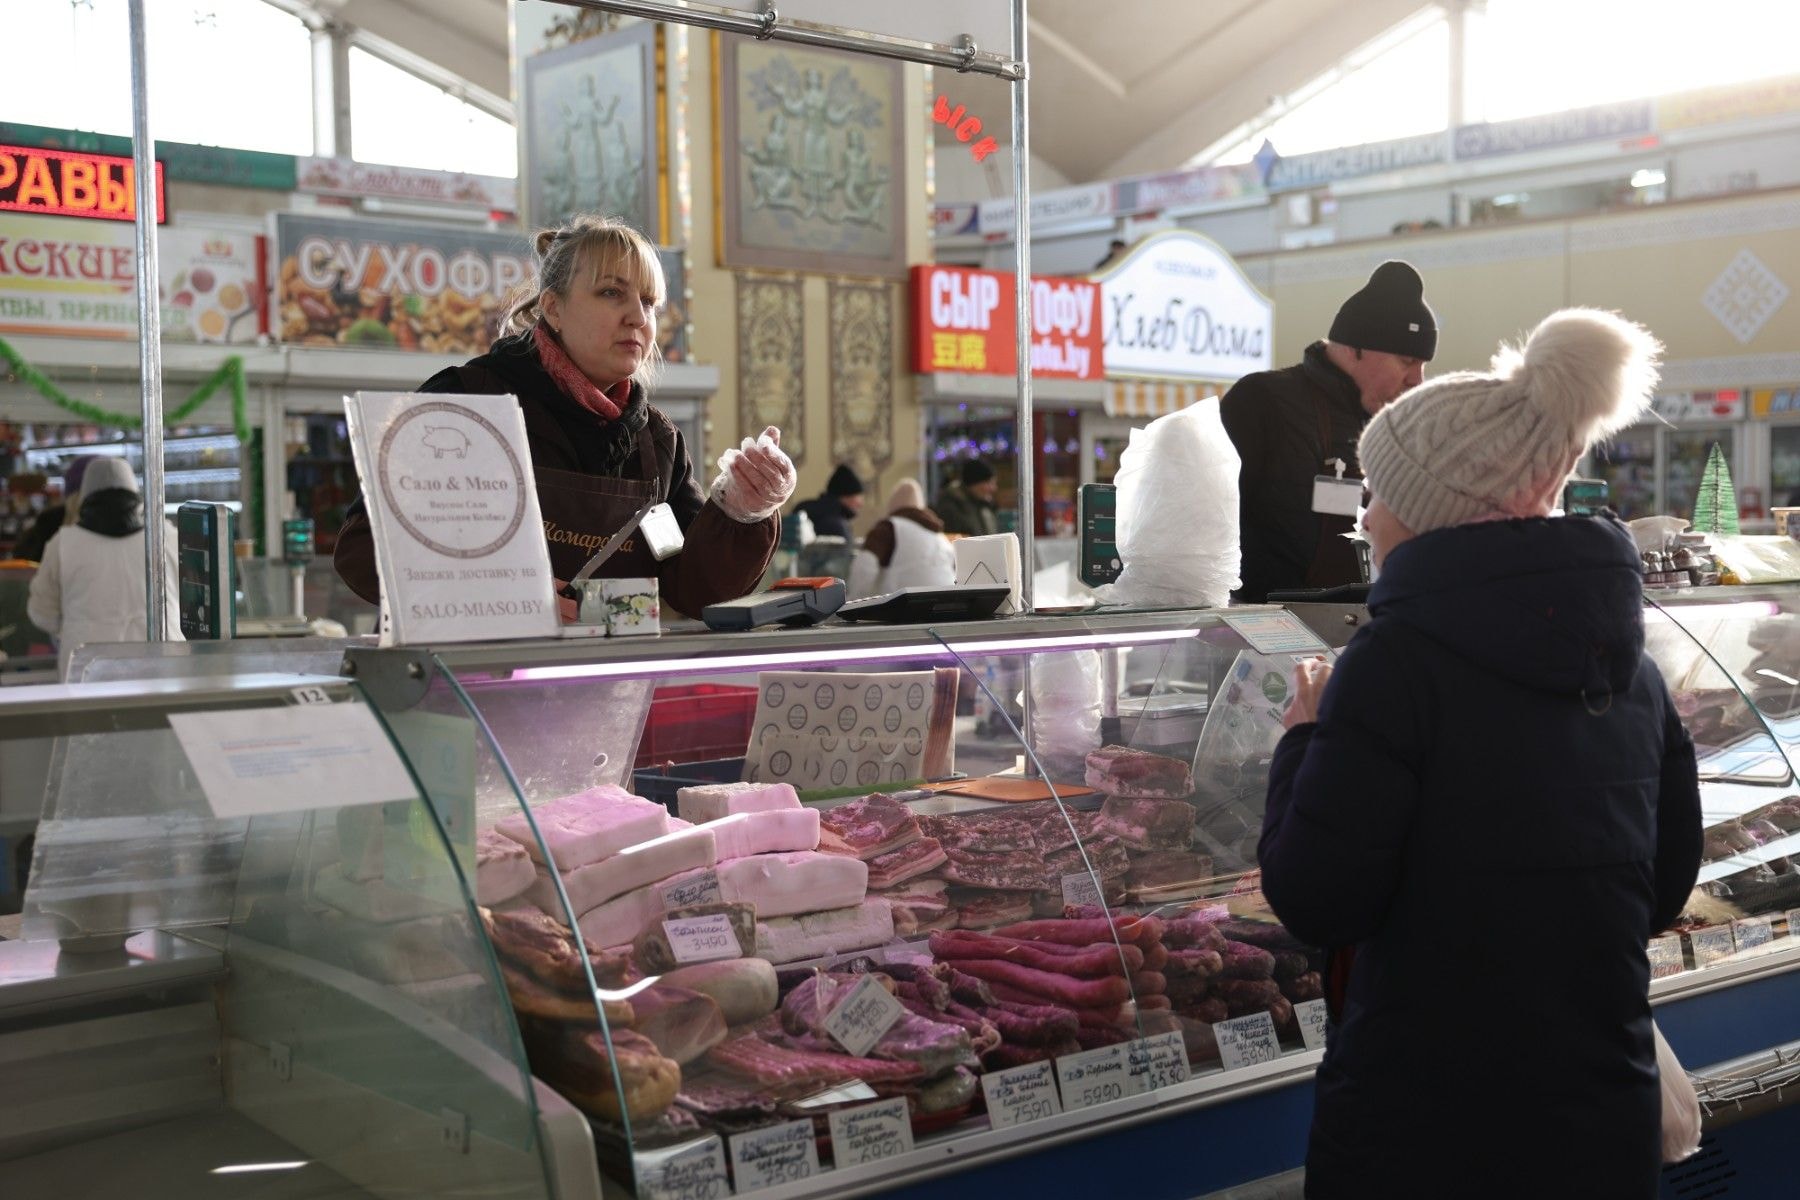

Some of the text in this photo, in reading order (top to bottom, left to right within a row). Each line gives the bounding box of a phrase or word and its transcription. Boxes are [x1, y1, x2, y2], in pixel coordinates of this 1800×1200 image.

[930, 270, 1000, 331] СЫР
[1102, 292, 1263, 358] Хлеб Дома
[399, 475, 508, 492] Сало & Мясо
[404, 567, 537, 582] Закажи доставку на
[412, 600, 543, 619] SALO-MIASO.BY
[300, 690, 323, 703] 12
